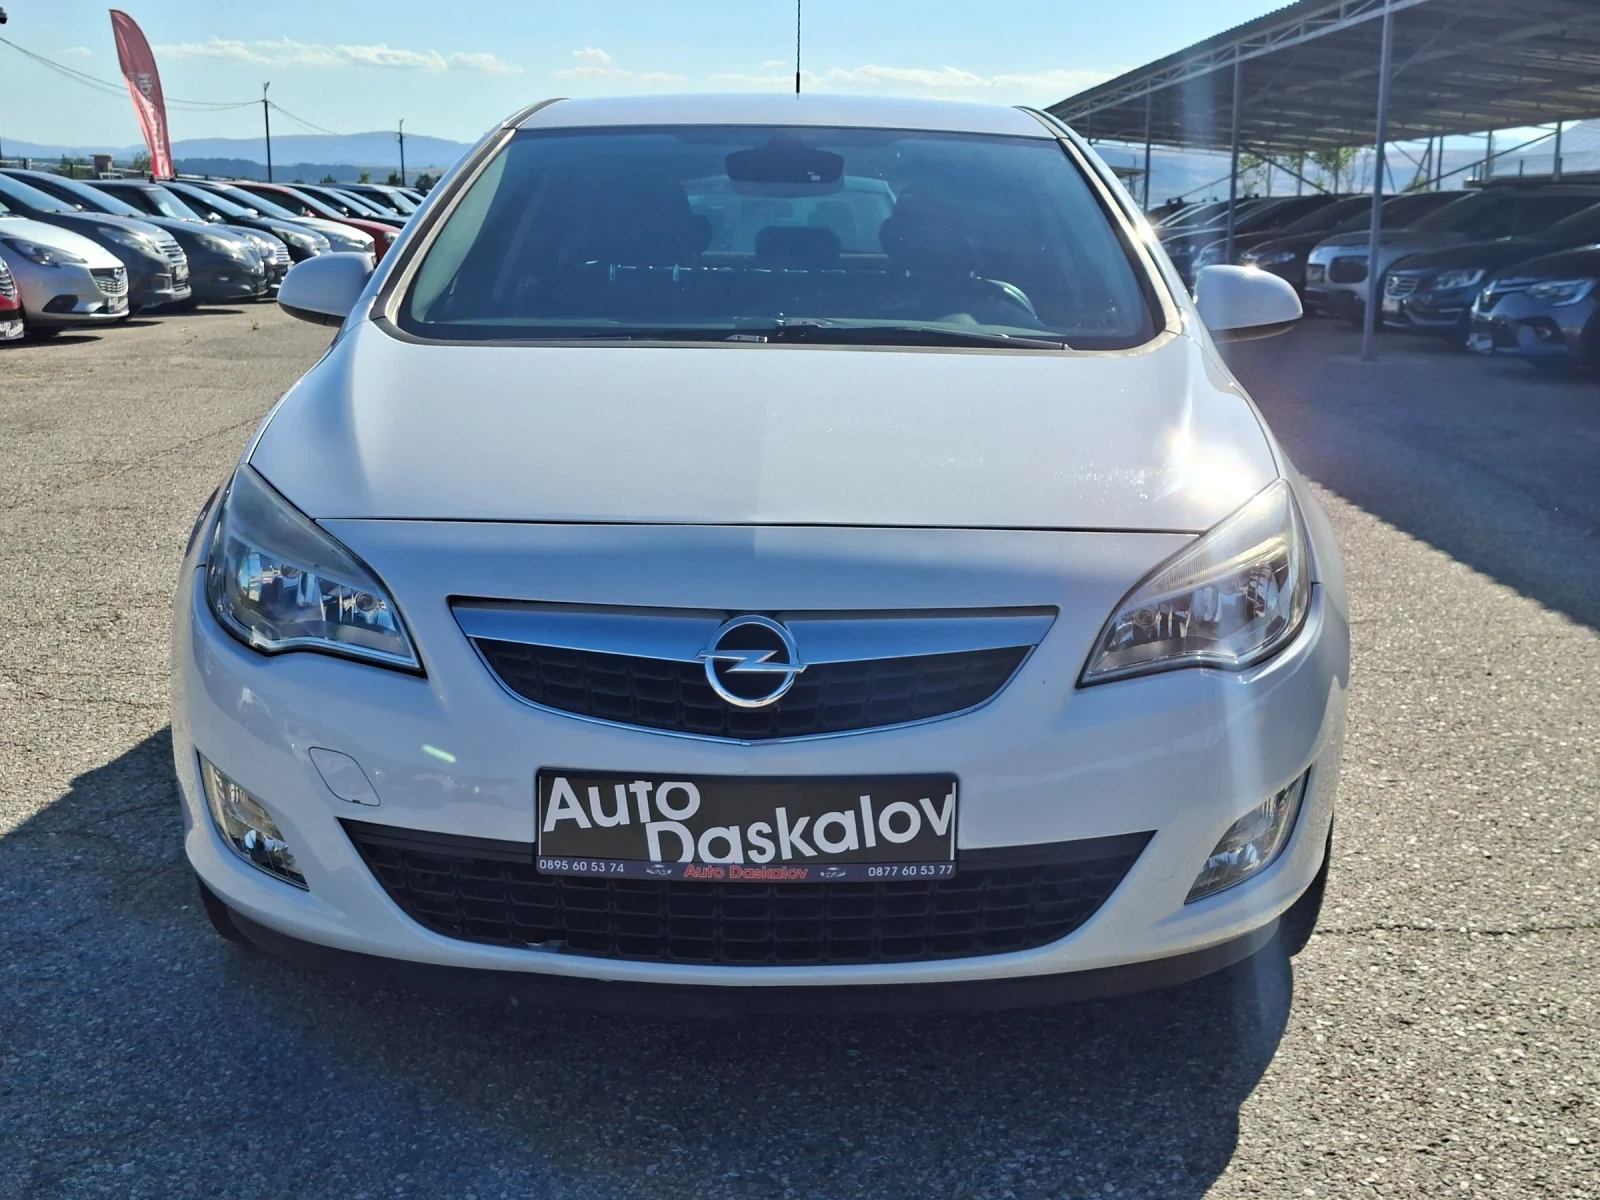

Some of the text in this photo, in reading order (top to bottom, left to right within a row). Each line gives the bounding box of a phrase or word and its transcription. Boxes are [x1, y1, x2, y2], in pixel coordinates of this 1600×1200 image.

[543, 777, 701, 833] Auto
[645, 793, 954, 864] Daskalov
[539, 859, 625, 873] 0895 60 53 74
[684, 864, 809, 879] Auto Daskalov
[868, 865, 953, 877] 0877 60 53 77
